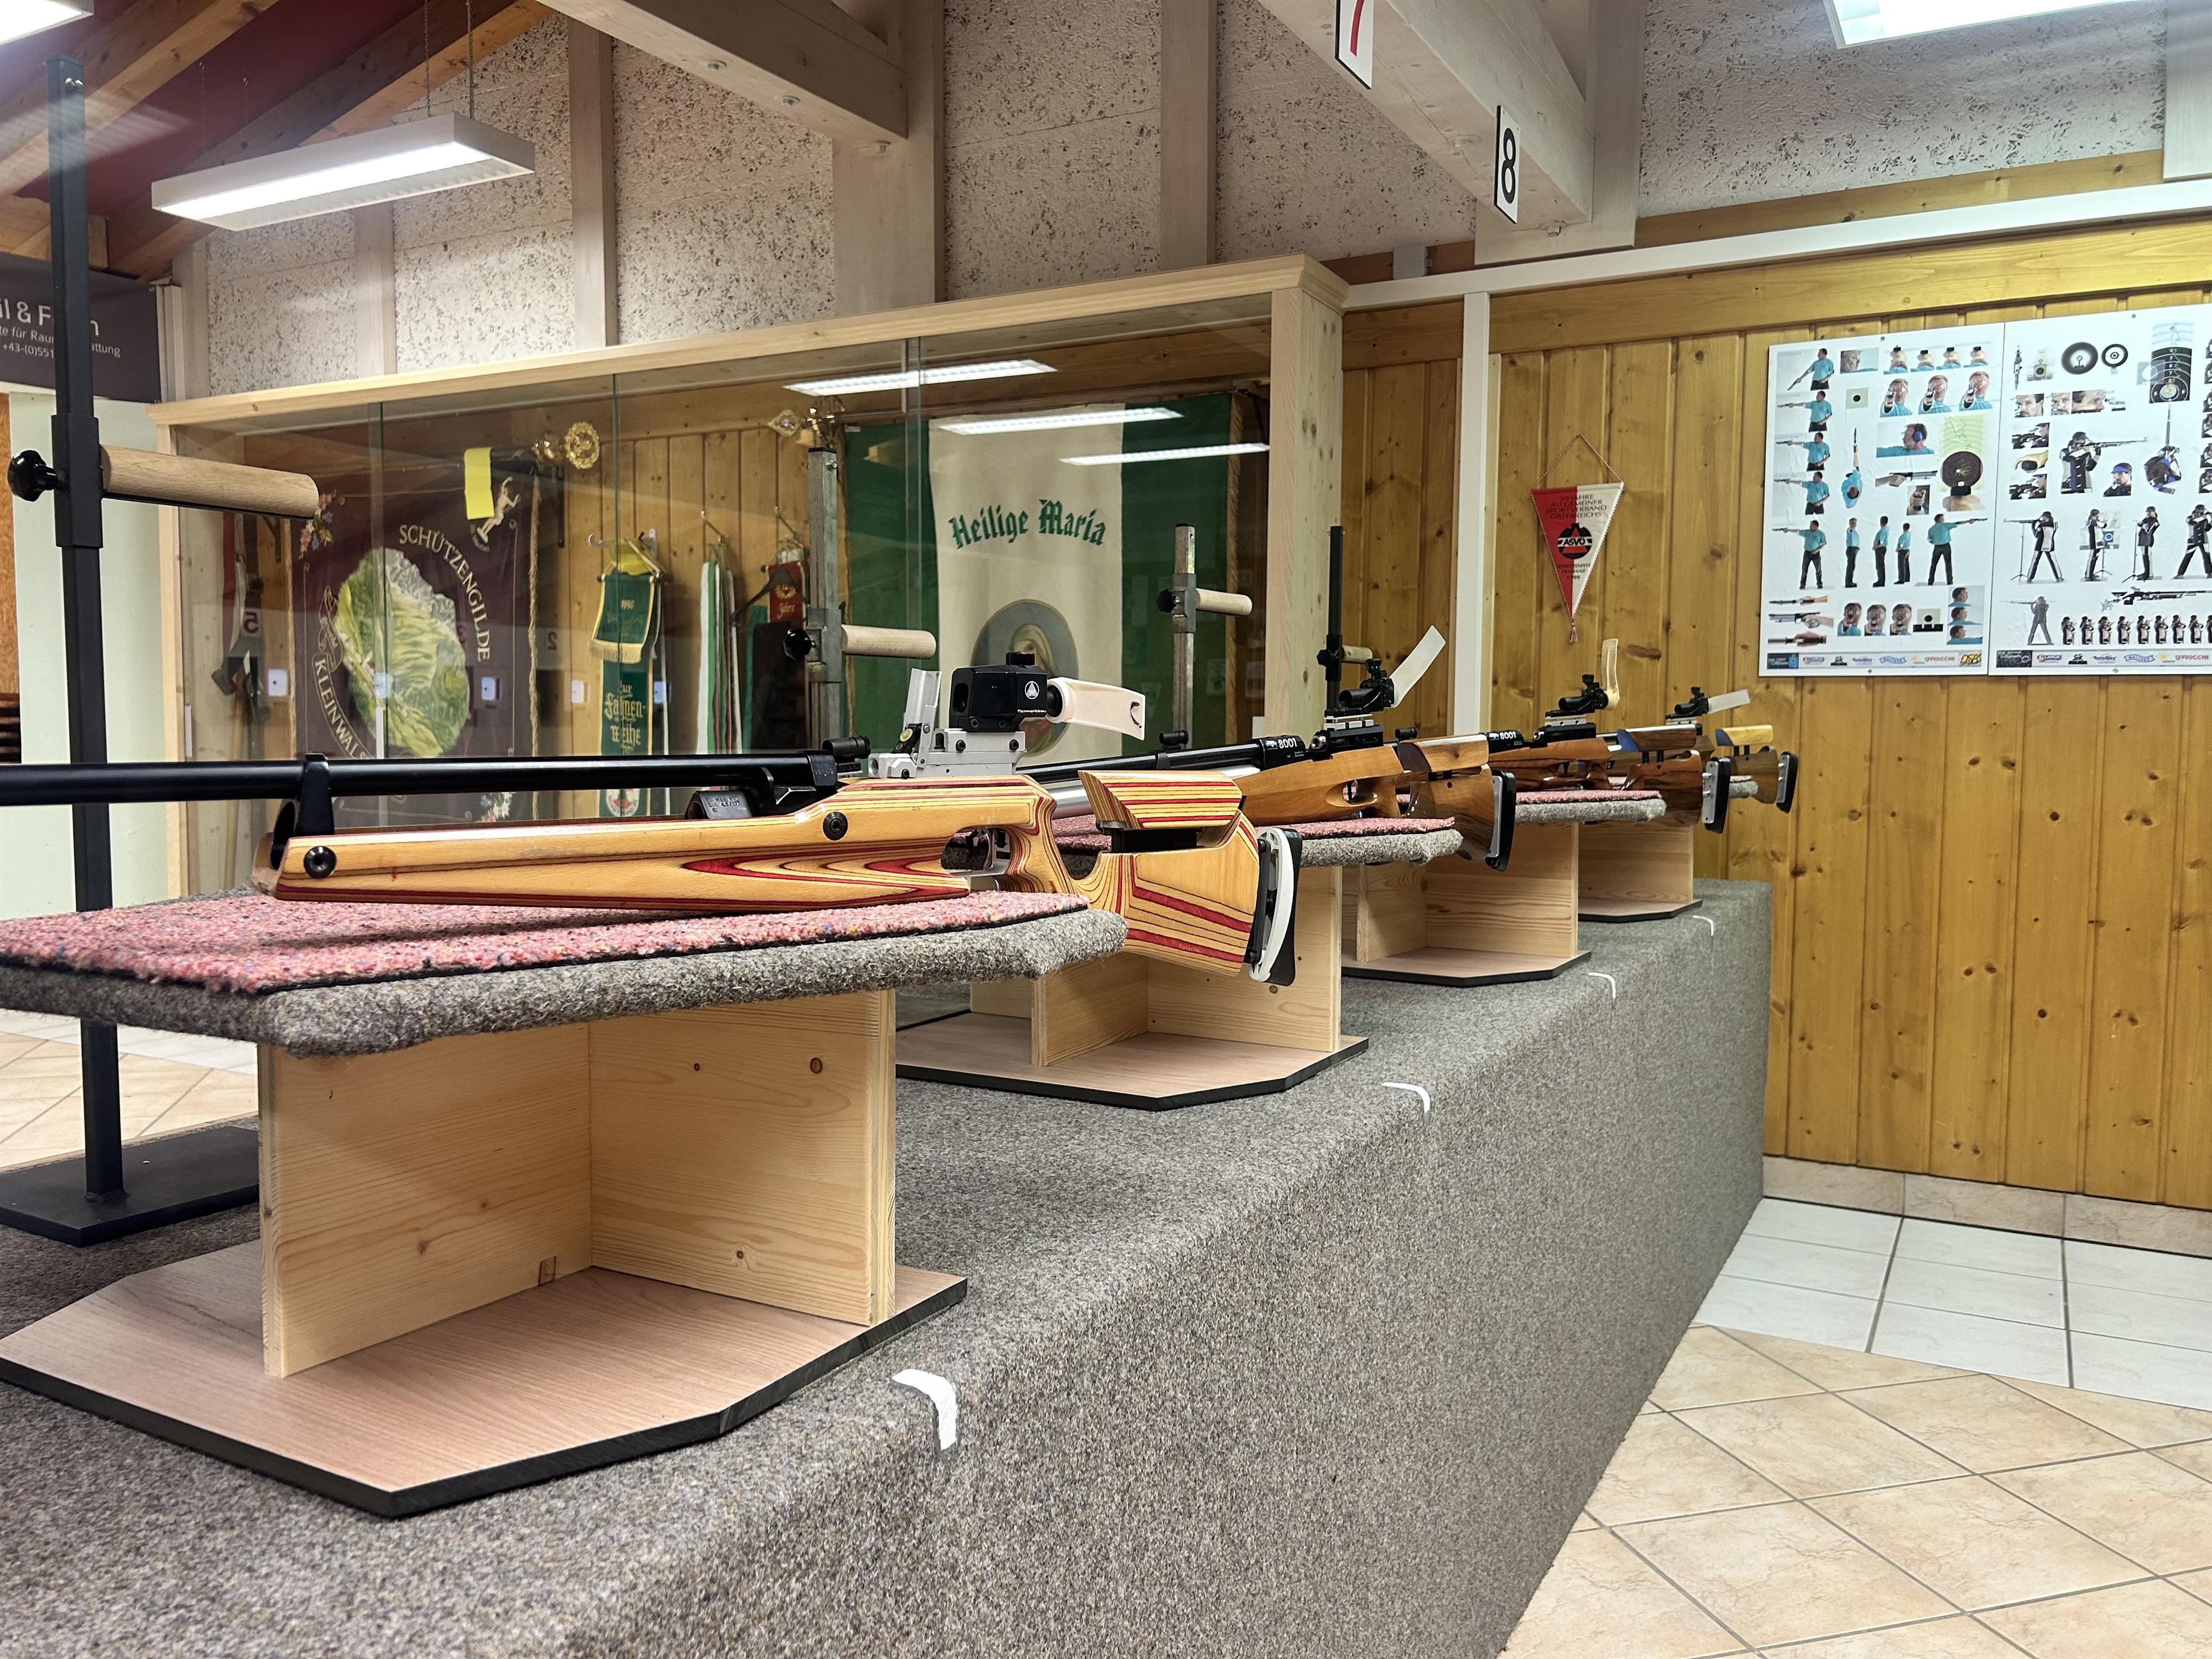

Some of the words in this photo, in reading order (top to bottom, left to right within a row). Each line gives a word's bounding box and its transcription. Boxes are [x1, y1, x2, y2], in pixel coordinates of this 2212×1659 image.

[1501, 128, 1516, 204] 8
[17, 301, 32, 324] &
[12, 326, 27, 339] für
[2, 342, 54, 358] +43-(0)551
[1546, 504, 1608, 514] SPORTVERBAND
[1550, 499, 1603, 508] ALLGEMEINER
[948, 504, 1029, 549] Heilige
[1039, 499, 1106, 546] Maria
[399, 524, 491, 662] SCHÜTZENGILDE
[1499, 731, 1516, 740] 8001
[1278, 737, 1297, 749] 8001
